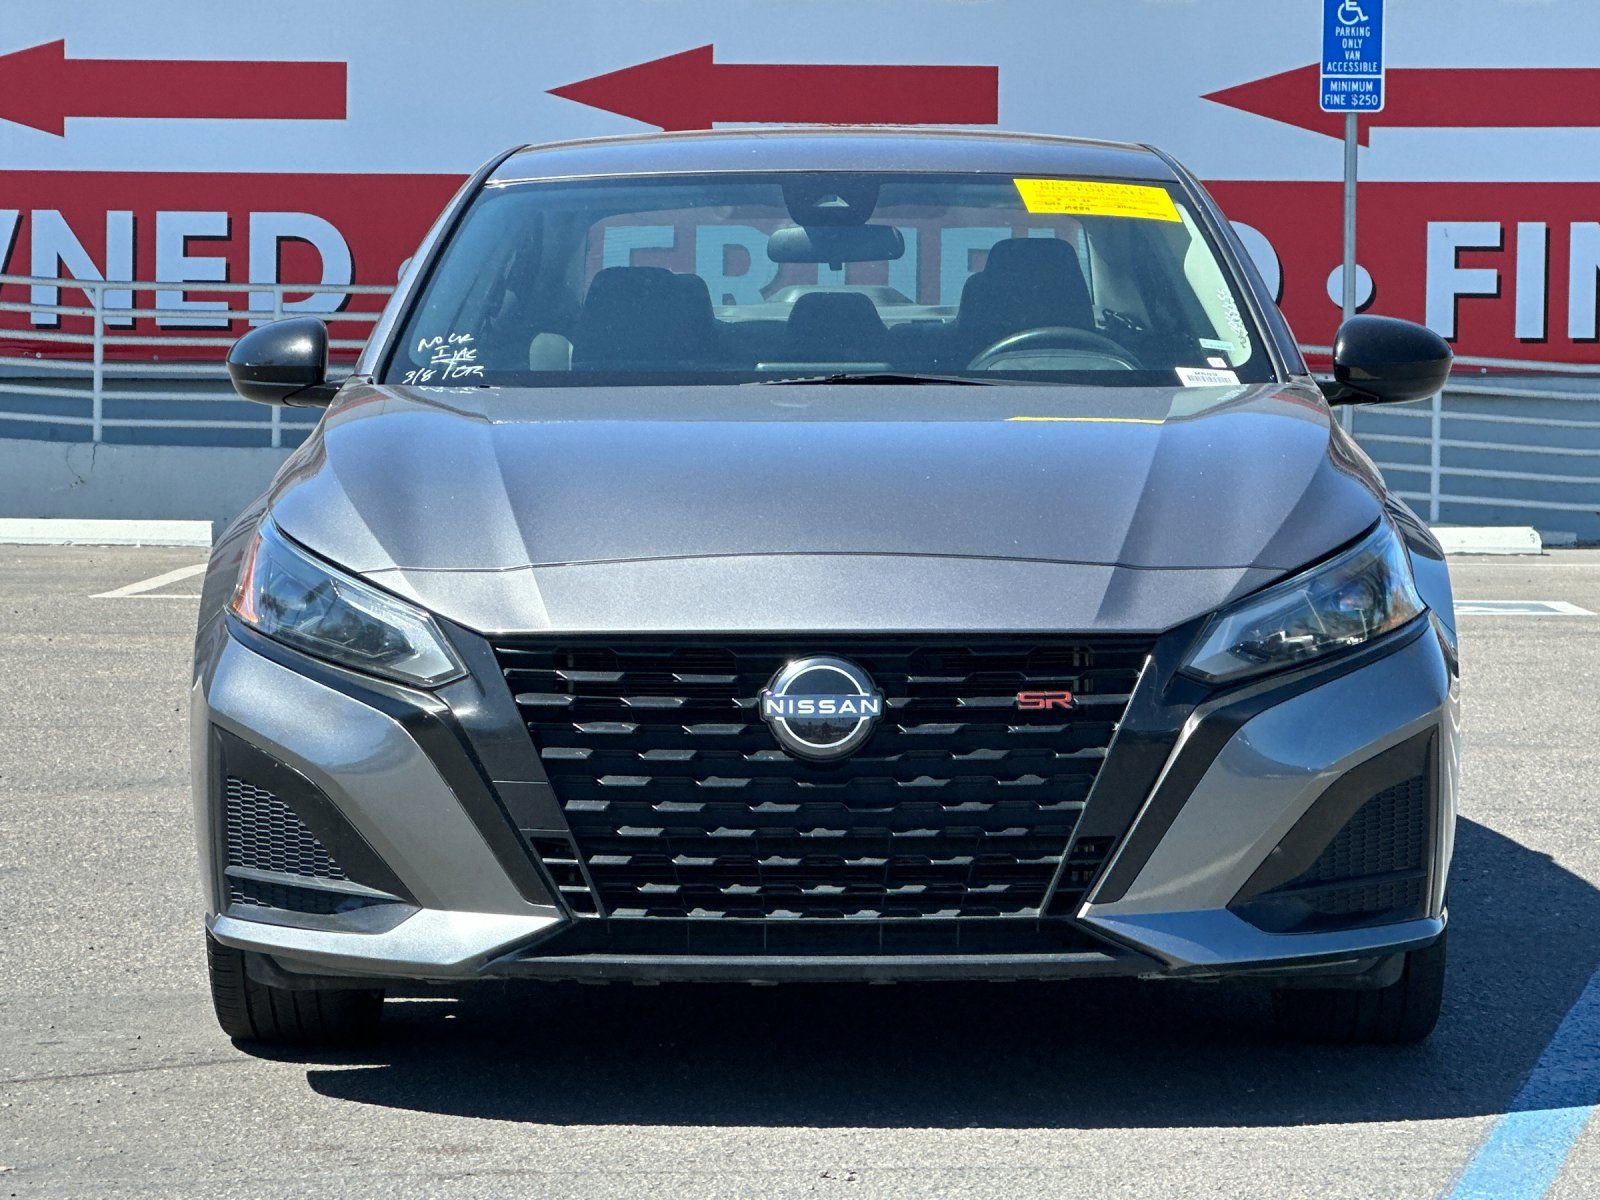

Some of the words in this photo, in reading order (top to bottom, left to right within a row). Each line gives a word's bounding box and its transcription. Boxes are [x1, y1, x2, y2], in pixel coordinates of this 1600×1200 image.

[1335, 26, 1371, 37] PARKING
[1342, 38, 1363, 49] ONLY
[1345, 50, 1360, 60] VAN
[1327, 62, 1378, 72] ACCESSIBLE
[1330, 81, 1373, 91] MINIMUM
[1325, 95, 1346, 105] FINE
[1351, 94, 1378, 106] $250
[1017, 691, 1073, 709] SR
[765, 699, 879, 715] NISSAN
